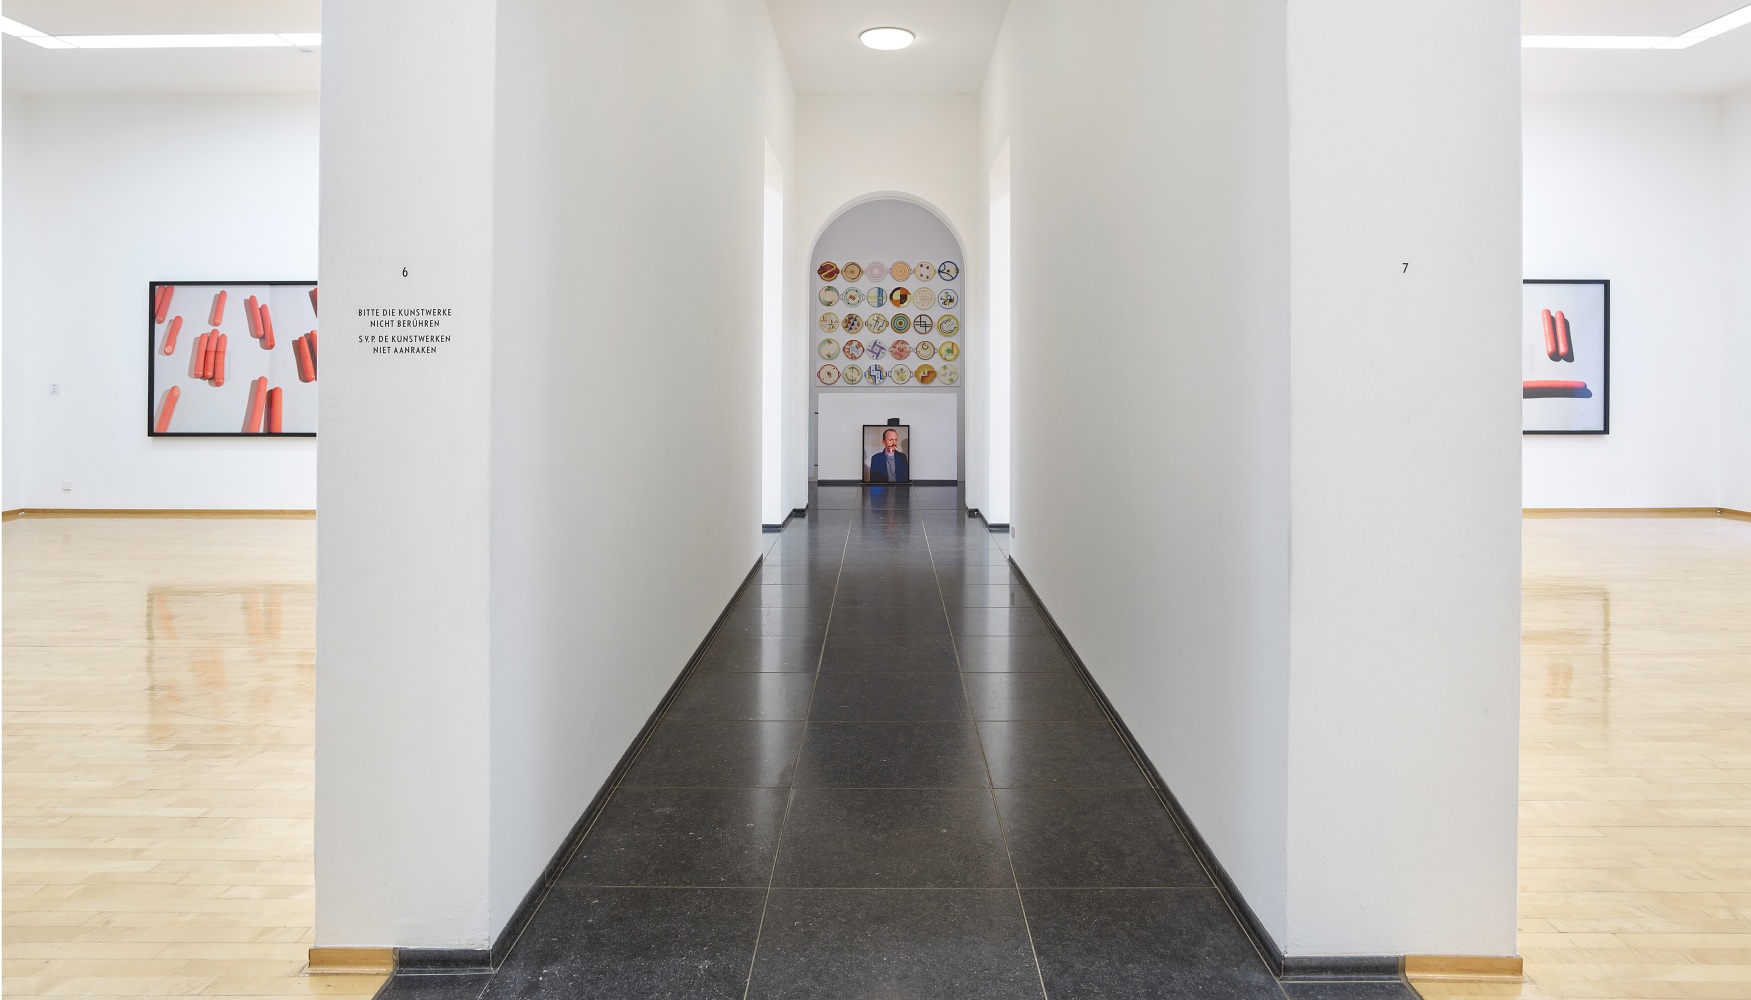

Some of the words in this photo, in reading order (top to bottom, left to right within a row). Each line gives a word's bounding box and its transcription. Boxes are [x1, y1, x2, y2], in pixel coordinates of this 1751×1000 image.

[402, 266, 409, 278] 6
[1402, 262, 1409, 274] 7
[358, 308, 380, 317] BITTE
[382, 308, 396, 317] DIE
[398, 308, 452, 317] KUNSTWERKE
[370, 319, 394, 328] NICHT
[397, 318, 440, 328] BERÜHREN
[378, 335, 389, 343] DE
[391, 335, 451, 343] KUNSTWERKEN
[373, 346, 391, 354] NIET
[393, 346, 437, 354] AANRAKEN
